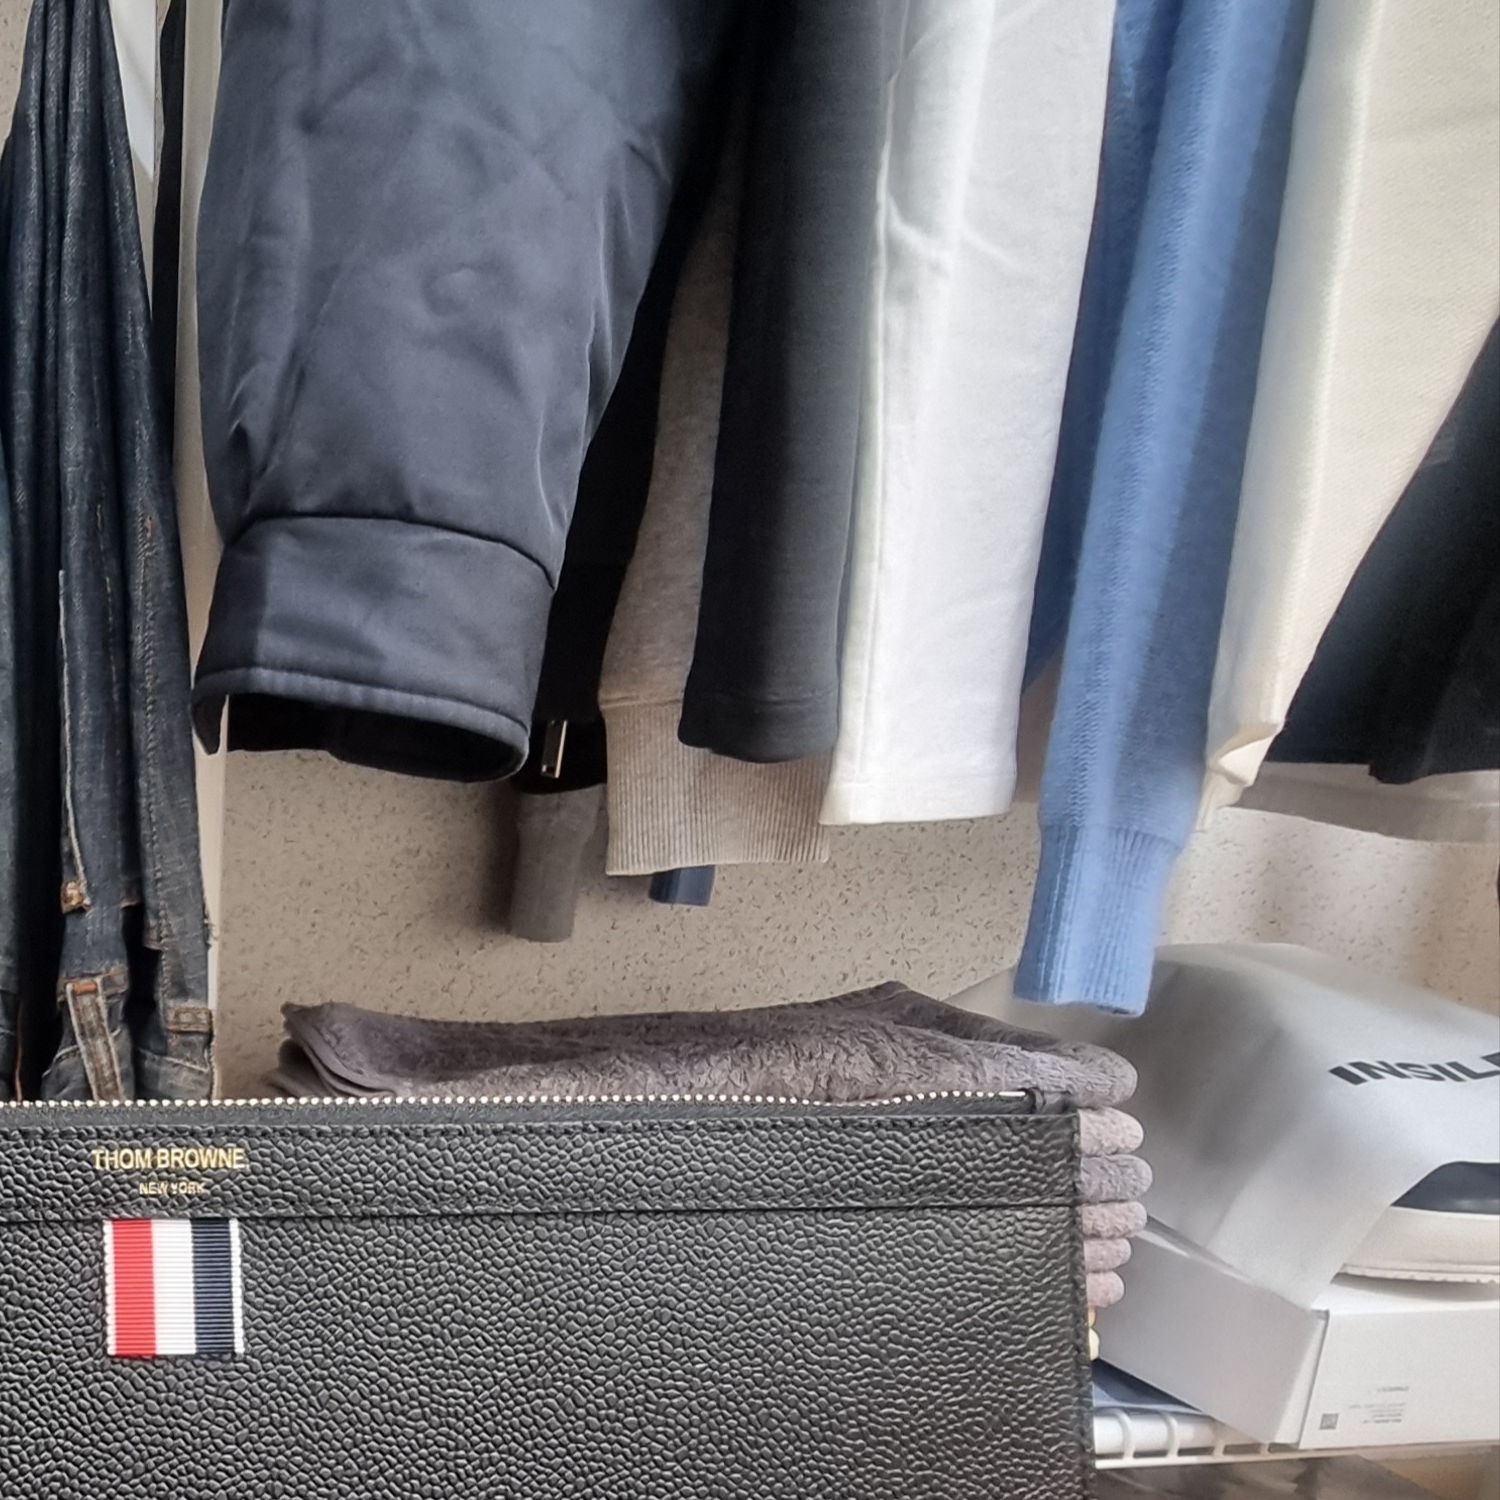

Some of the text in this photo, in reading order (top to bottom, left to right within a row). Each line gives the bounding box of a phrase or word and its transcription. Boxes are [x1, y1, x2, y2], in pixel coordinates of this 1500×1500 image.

[1328, 1051, 1500, 1086] INSIL
[92, 1148, 152, 1170] THOM
[139, 1181, 206, 1195] NEW YORK
